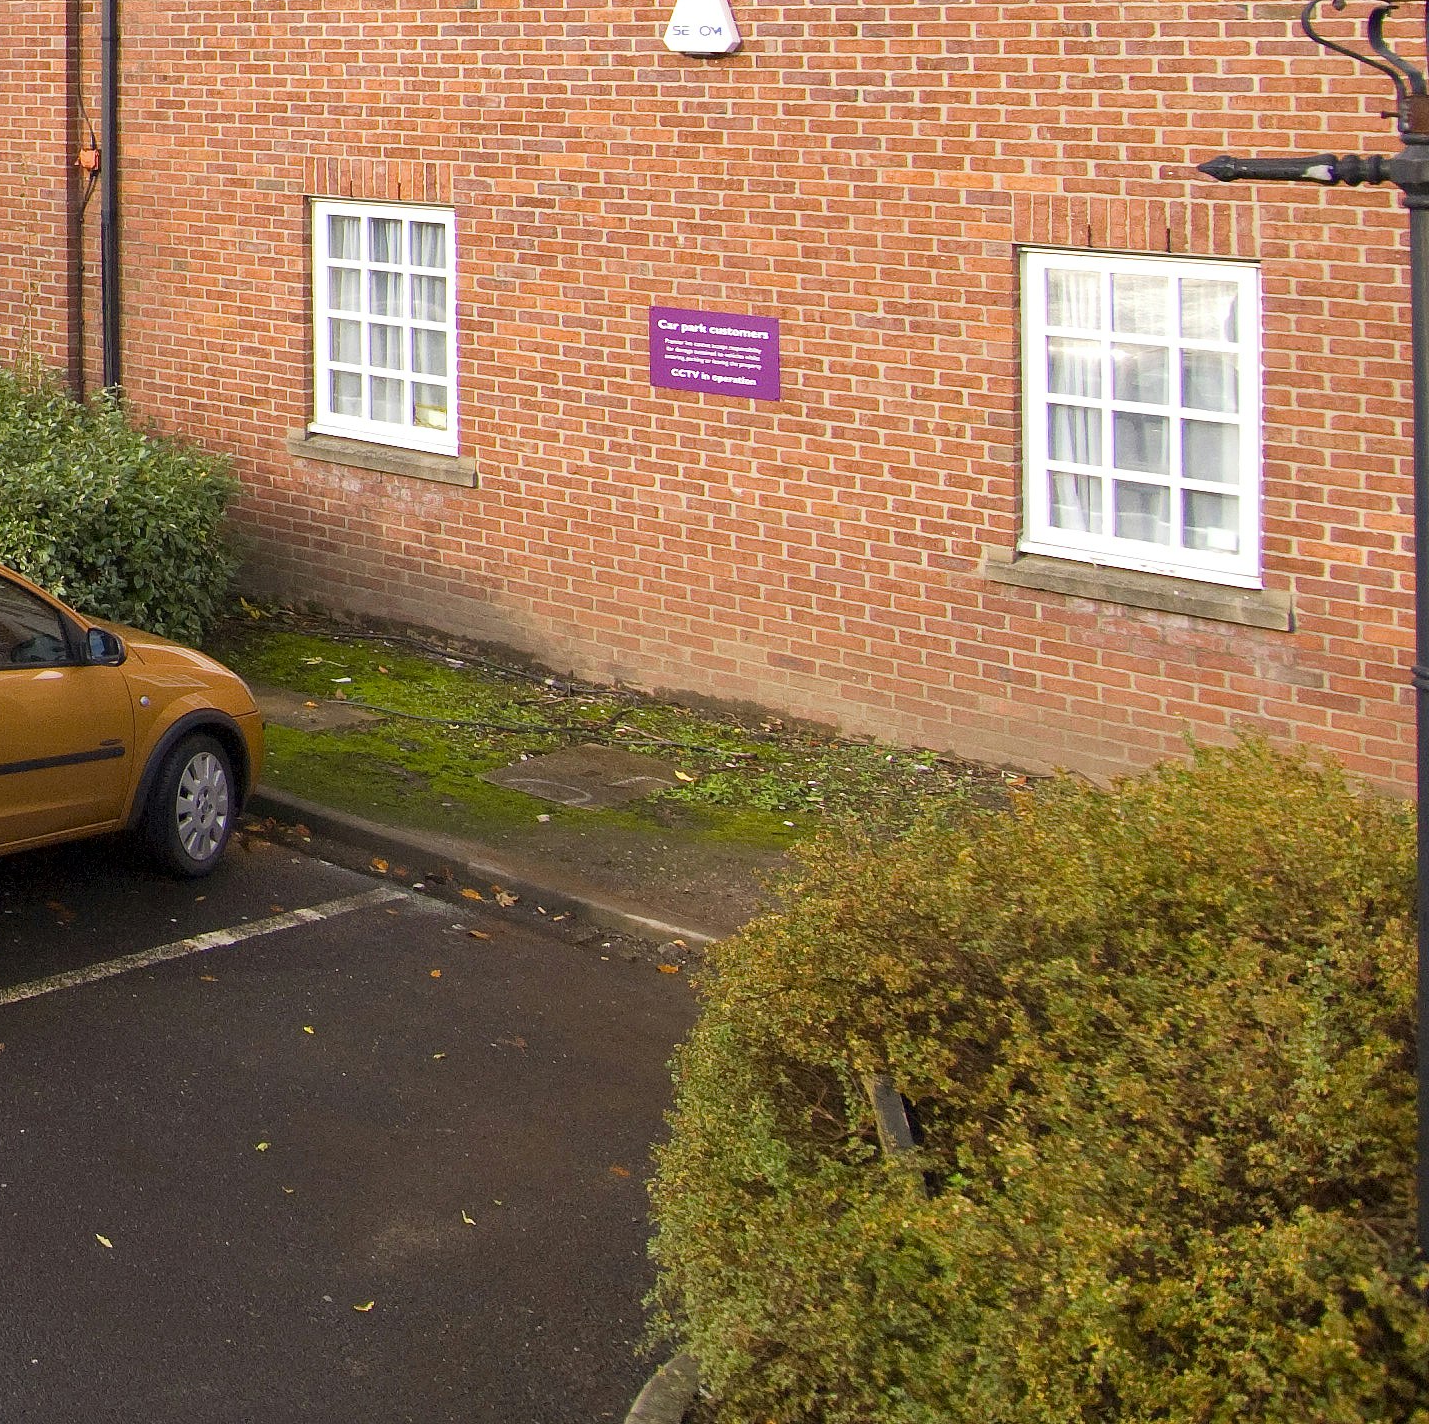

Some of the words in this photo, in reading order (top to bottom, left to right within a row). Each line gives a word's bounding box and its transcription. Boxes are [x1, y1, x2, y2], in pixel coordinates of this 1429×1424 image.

[657, 319, 680, 330] Car
[680, 323, 708, 334] park
[708, 326, 770, 340] customers
[670, 368, 700, 379] CCTV
[701, 371, 711, 381] in
[711, 373, 757, 386] operation
